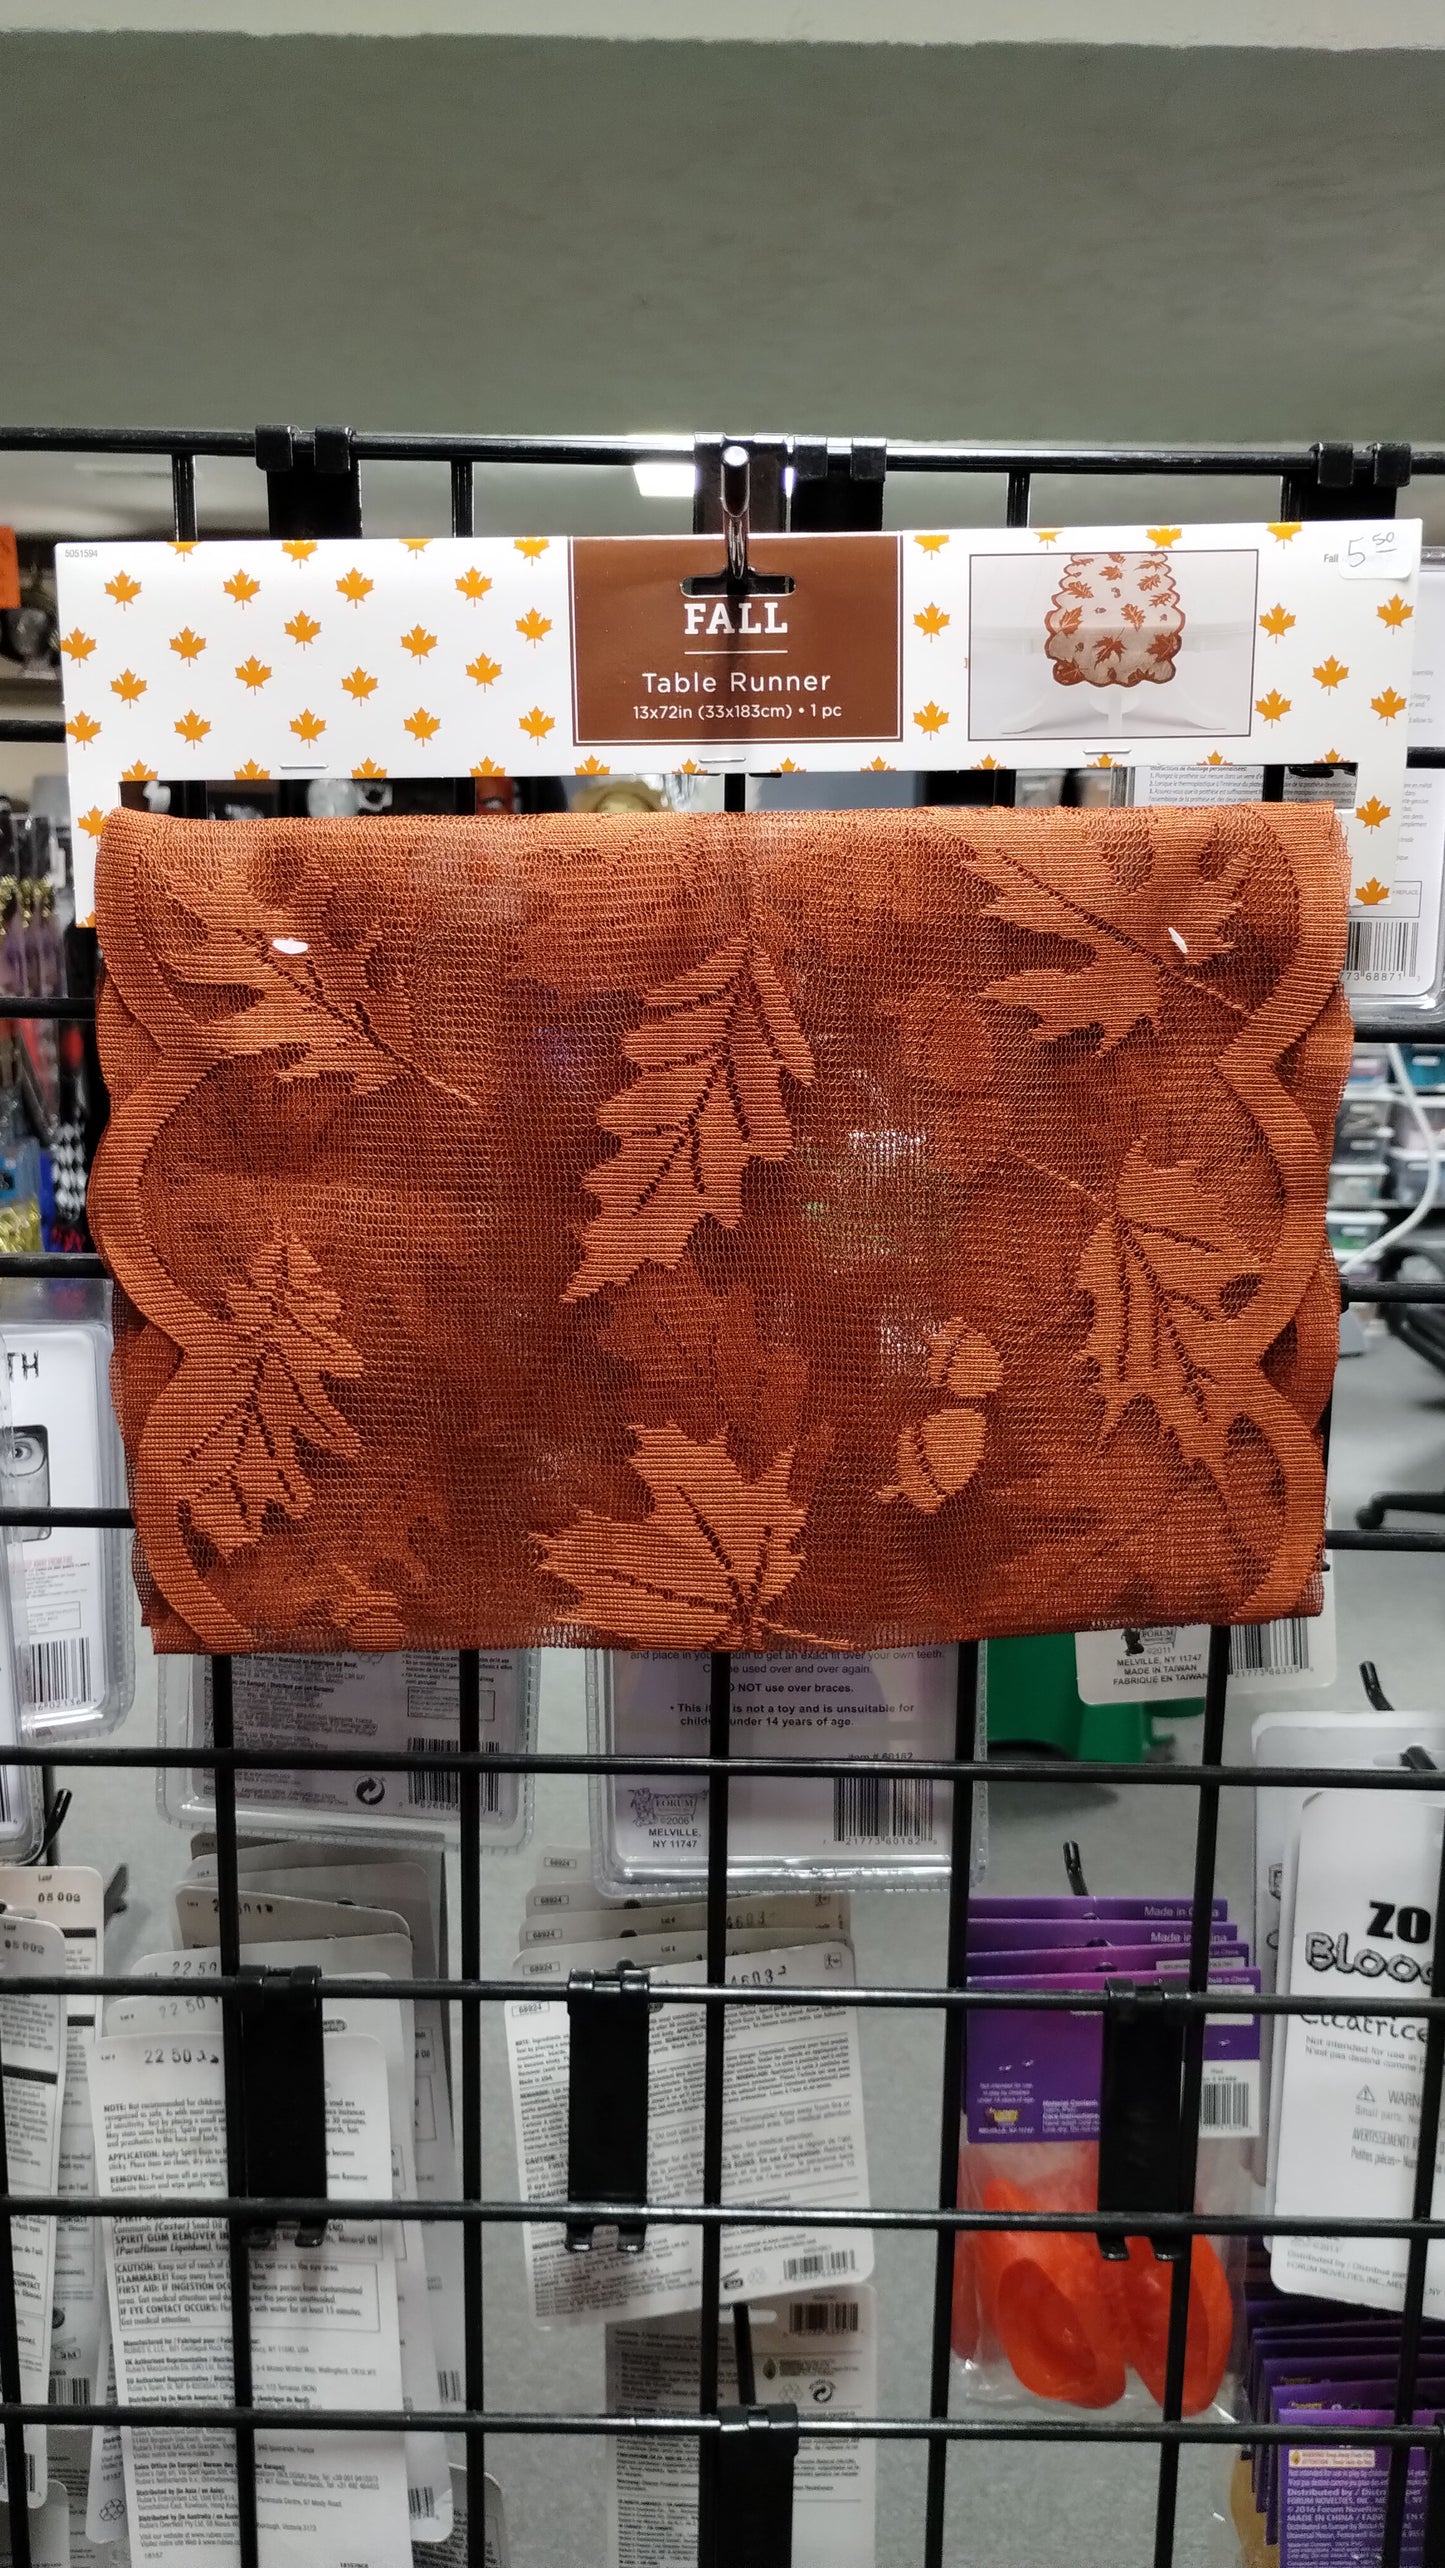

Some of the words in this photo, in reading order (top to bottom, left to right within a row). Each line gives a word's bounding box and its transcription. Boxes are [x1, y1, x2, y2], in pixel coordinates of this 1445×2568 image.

[65, 549, 98, 558] 5051594
[1348, 536, 1366, 568] 5
[1324, 553, 1339, 563] Fall
[684, 602, 788, 634] FALL
[641, 671, 717, 693] Table
[730, 671, 831, 692] Runner
[632, 705, 693, 720] 13x72in
[698, 704, 793, 720] (33x183cm)
[811, 703, 817, 717] 1
[822, 705, 842, 720] pc
[1164, 1656, 1177, 1664] NY
[742, 1663, 767, 1673] used
[769, 1665, 791, 1673] over
[794, 1663, 815, 1673] and
[817, 1664, 840, 1673] over
[841, 1663, 873, 1676] again.
[1124, 1666, 1149, 1676] MADE
[1152, 1665, 1162, 1675] IN
[1164, 1664, 1198, 1674] TAIWAN
[1161, 1674, 1174, 1683] EN
[737, 1683, 763, 1692] NOT
[764, 1685, 785, 1693] use
[787, 1685, 812, 1693] over
[814, 1682, 854, 1693] braces.
[677, 1703, 702, 1713] This
[733, 1703, 743, 1713] is
[746, 1704, 765, 1713] not
[768, 1705, 775, 1713] a
[778, 1704, 796, 1716] toy
[800, 1703, 820, 1713] and
[823, 1703, 834, 1713] is
[836, 1702, 897, 1713] unsuitable
[899, 1702, 915, 1713] for
[731, 1717, 763, 1727] under
[766, 1717, 778, 1727] 14
[782, 1718, 813, 1729] years
[816, 1717, 829, 1727] of
[831, 1719, 855, 1730] age.
[655, 1799, 694, 1809] FORUM
[652, 1839, 668, 1849] NY
[670, 1839, 698, 1849] 11747
[885, 1836, 922, 1846] 60182
[1144, 1906, 1175, 1917] Made
[1176, 1907, 1186, 1917] in
[1150, 1931, 1182, 1943] Made
